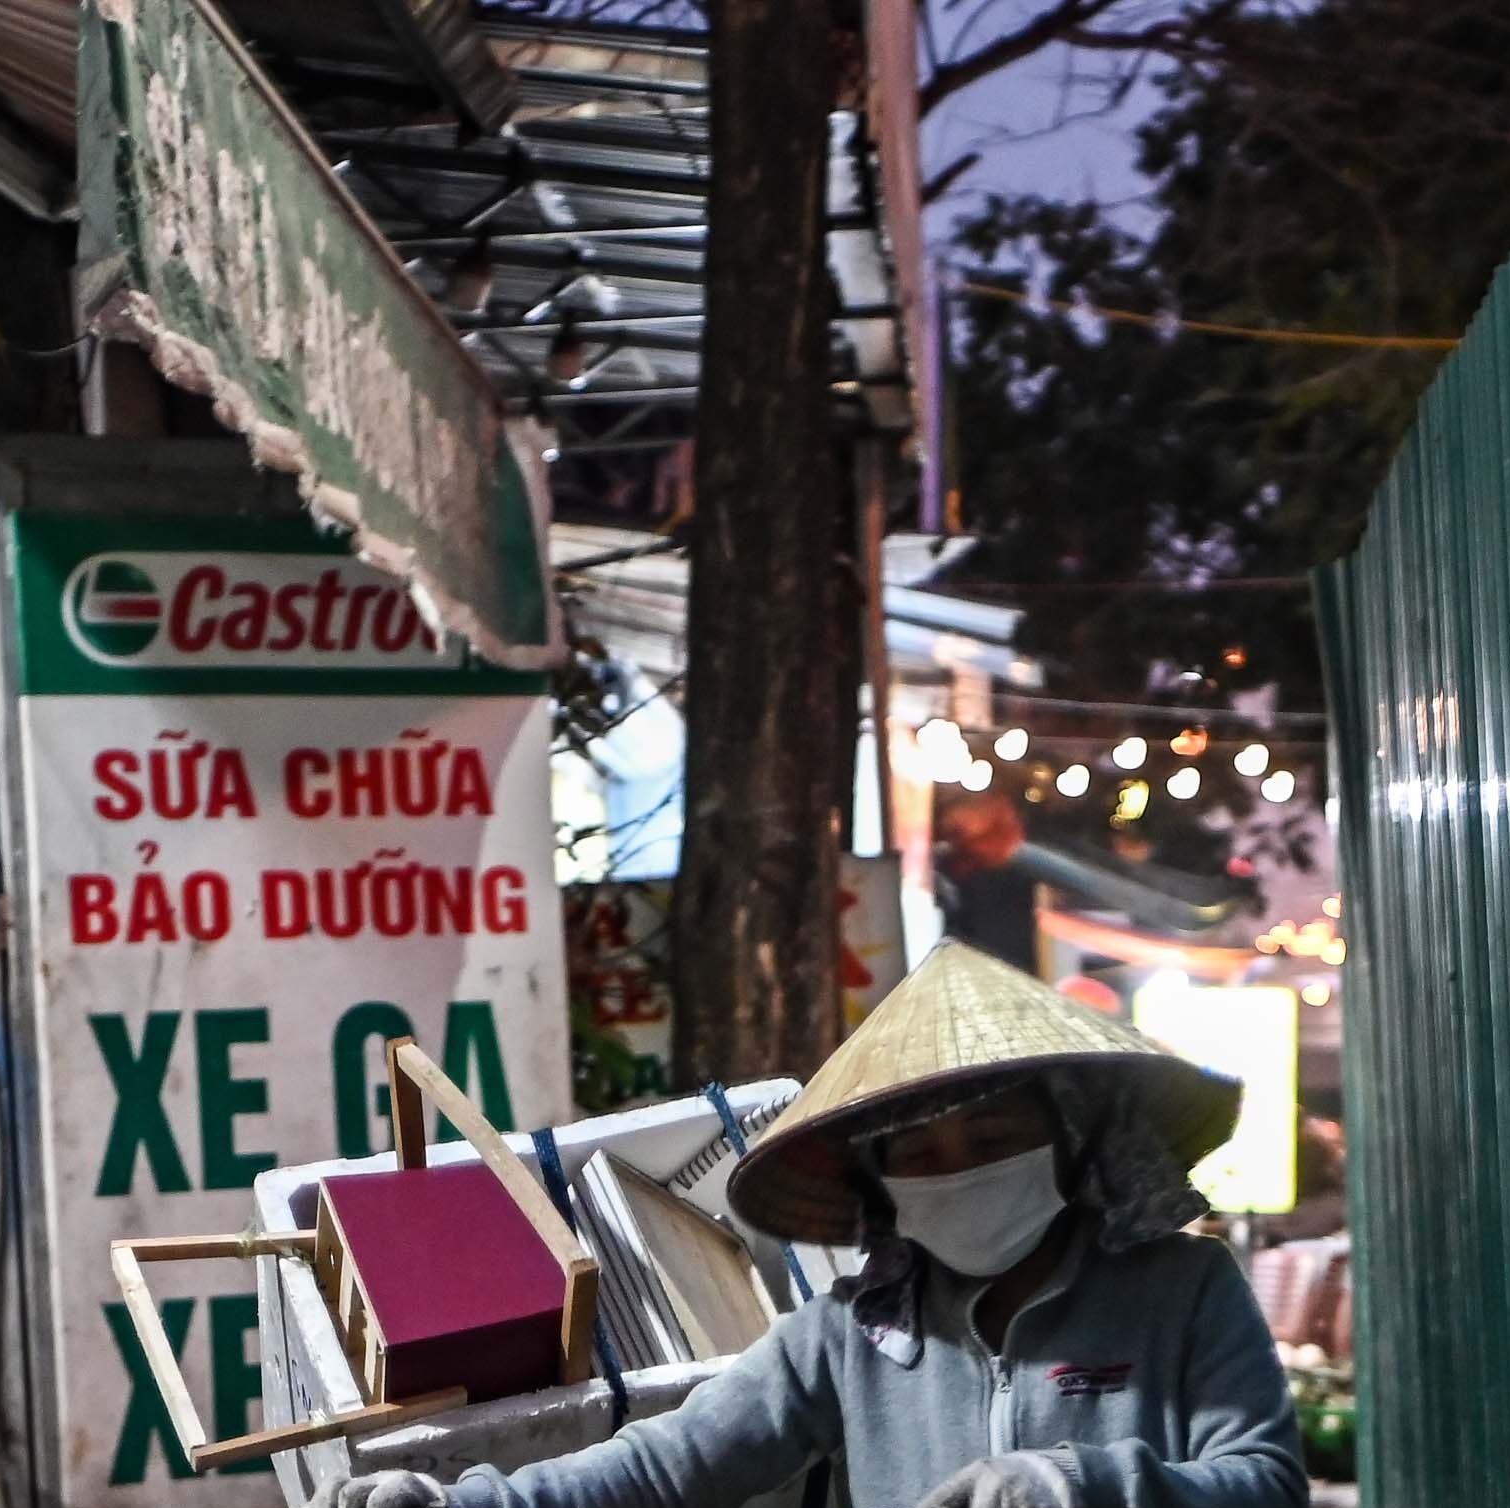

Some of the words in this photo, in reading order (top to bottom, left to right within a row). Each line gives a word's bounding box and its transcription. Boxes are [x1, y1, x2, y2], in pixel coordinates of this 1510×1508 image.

[169, 563, 438, 654] Castro
[93, 728, 258, 822] SỮA
[283, 727, 494, 819] CHỮA
[68, 839, 232, 945] BẢO
[260, 847, 528, 940] DƯỠNG
[86, 1006, 279, 1197] XE
[331, 1000, 520, 1161] GA
[101, 1295, 272, 1488] XE
